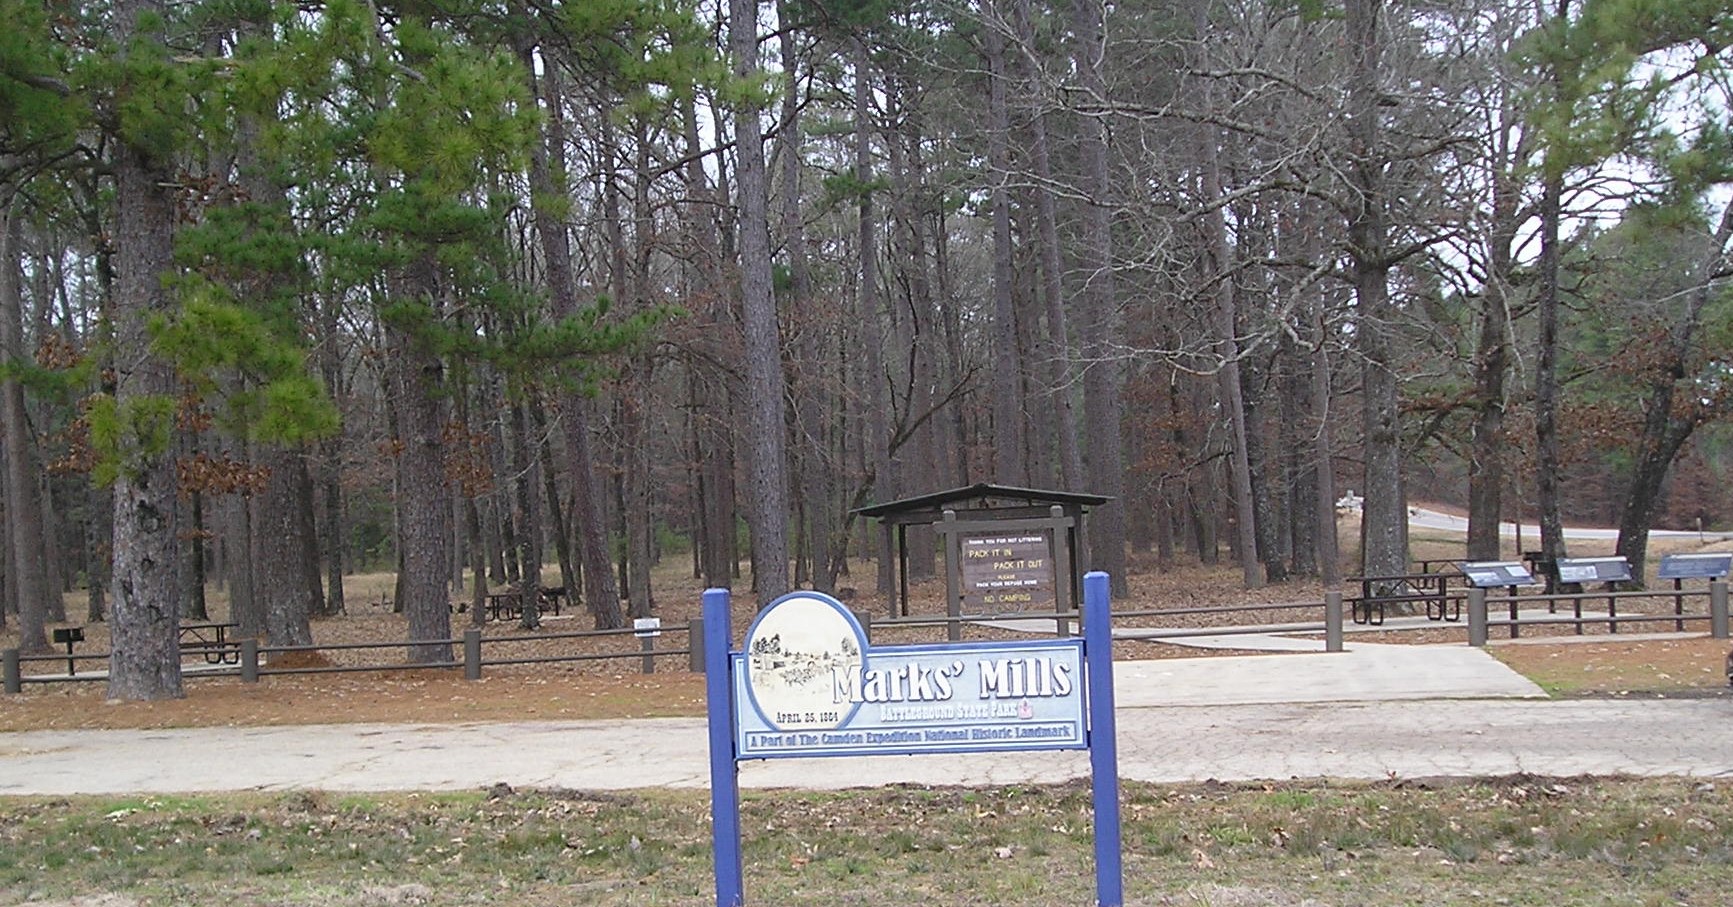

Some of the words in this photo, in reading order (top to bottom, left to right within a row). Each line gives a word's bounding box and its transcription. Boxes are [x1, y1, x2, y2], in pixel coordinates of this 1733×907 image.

[968, 550, 988, 558] PACK
[992, 549, 1000, 557] IT
[1003, 547, 1012, 556] IN
[993, 562, 1014, 570] PACK
[1016, 561, 1025, 569] IT
[1028, 560, 1043, 568] OUT
[984, 595, 995, 603] NO
[999, 593, 1031, 602] CAMPING
[832, 659, 964, 703] Marks'
[978, 657, 1072, 699] Mills
[751, 736, 757, 747] A
[761, 735, 783, 747] Part
[786, 734, 796, 745] of
[799, 733, 818, 745] The
[821, 732, 863, 745] Camden
[866, 730, 921, 744] Expedition
[924, 729, 969, 742] National
[972, 727, 1012, 740] Historic
[1015, 725, 1070, 739] Landmark
